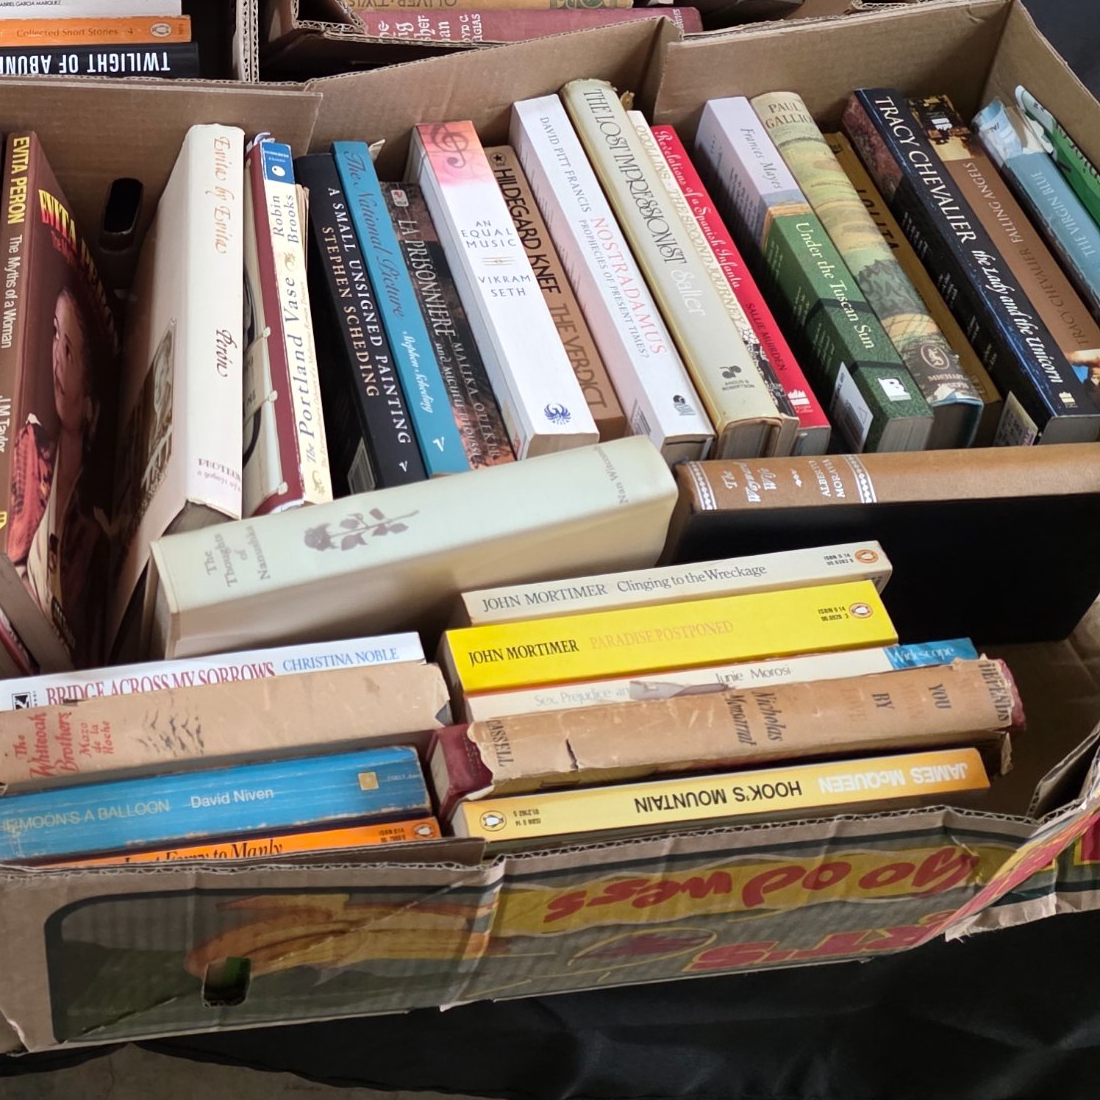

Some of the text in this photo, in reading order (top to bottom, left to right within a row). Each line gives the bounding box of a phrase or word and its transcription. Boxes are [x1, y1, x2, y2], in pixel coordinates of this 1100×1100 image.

[59, 54, 79, 72] OF
[88, 52, 170, 72] TWILIGHT
[875, 96, 977, 245] TRACY CHEVALIER
[461, 228, 514, 239] EQUAL
[475, 219, 493, 227] AN
[466, 238, 517, 248] MUSIC
[478, 275, 531, 297] VIKRAM SETH
[591, 217, 666, 355] NOSTRADAMUS
[795, 222, 876, 349] Under the Tuscan Sun
[483, 583, 607, 612] JOHN MORTIMER
[283, 647, 399, 672] CHRISTINA NOBLE
[468, 639, 579, 667] JOHN MORTIMER
[817, 762, 968, 793] JAMES McQUEEN
[190, 786, 274, 809] David Niven
[634, 781, 803, 812] HOOK'S MOUNTAIN
